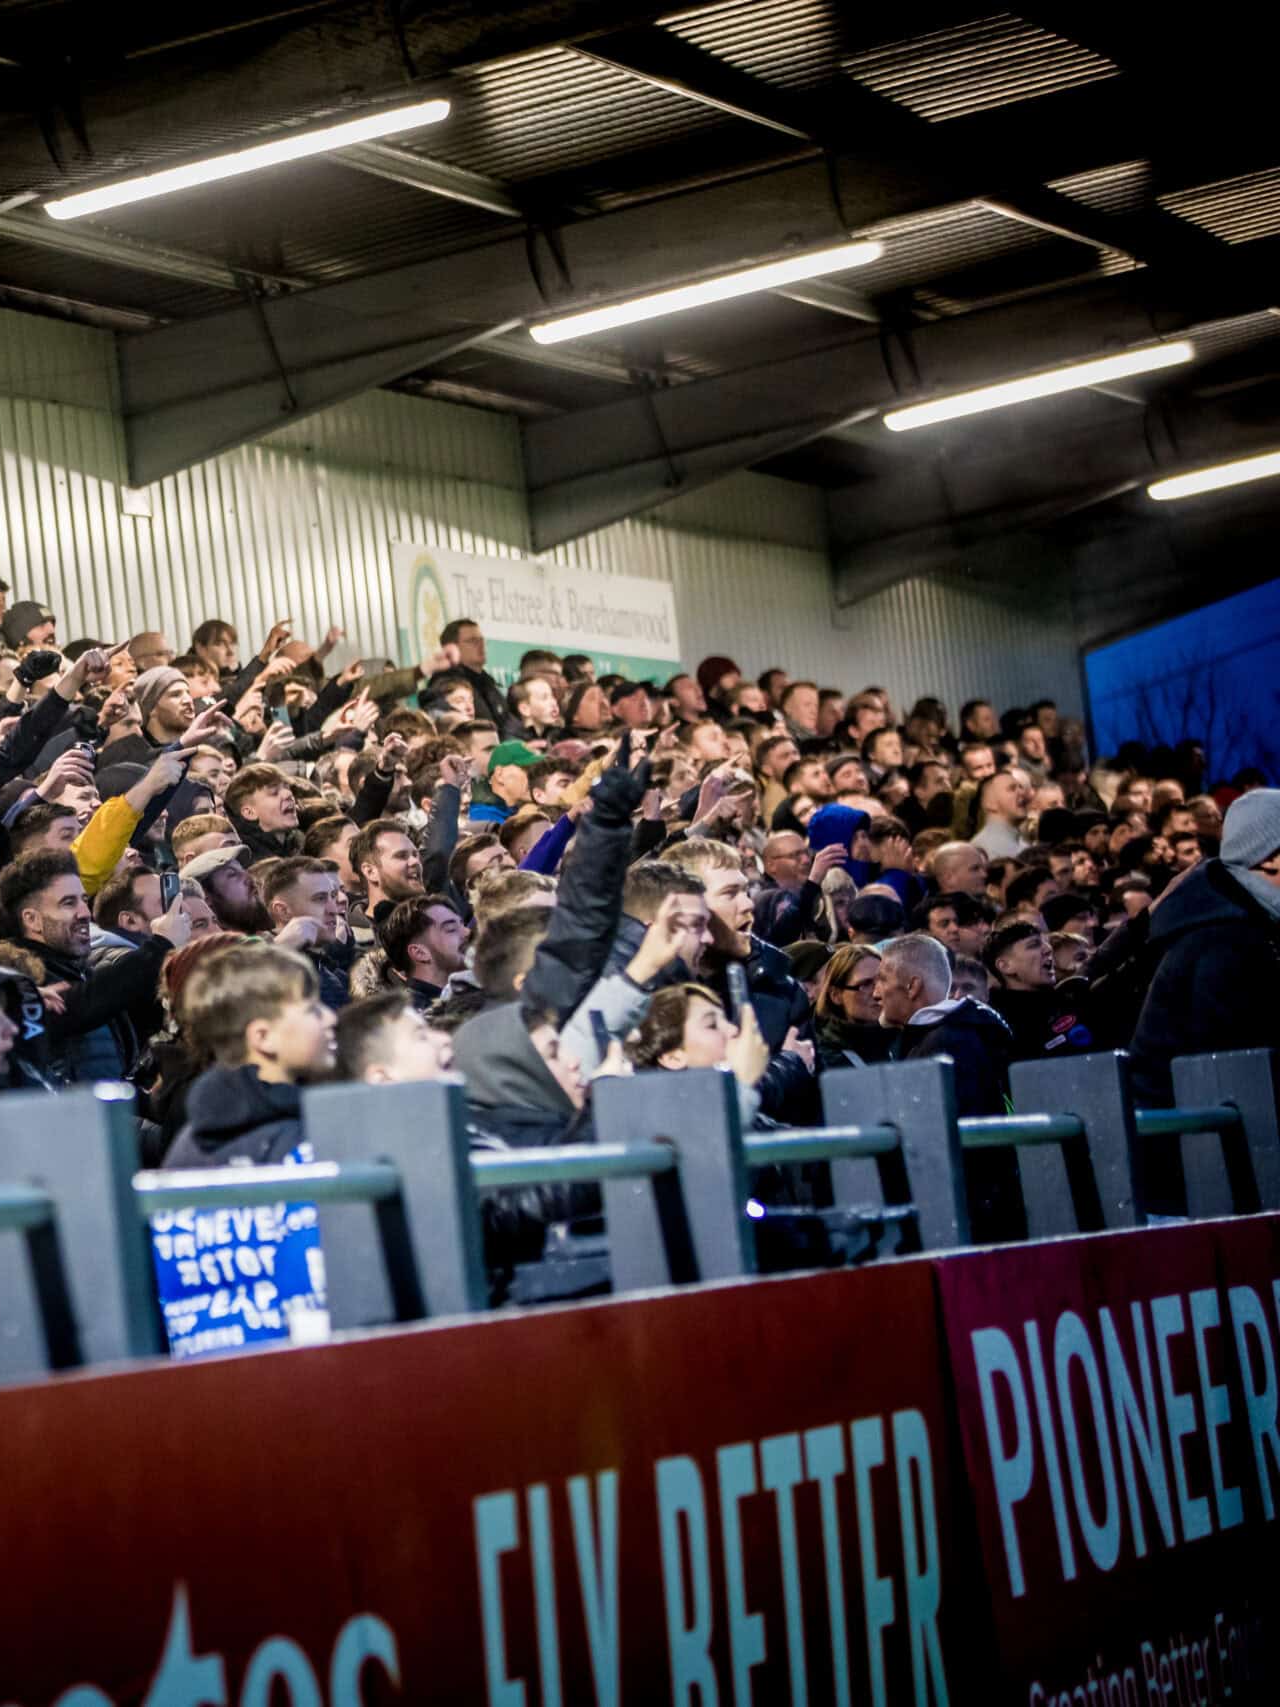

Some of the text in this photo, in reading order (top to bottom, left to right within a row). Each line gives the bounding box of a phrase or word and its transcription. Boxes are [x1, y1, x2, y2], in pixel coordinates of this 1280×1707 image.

[451, 572, 486, 621] The
[655, 1408, 950, 1707] BETTER
[970, 1278, 1280, 1598] PIONEER
